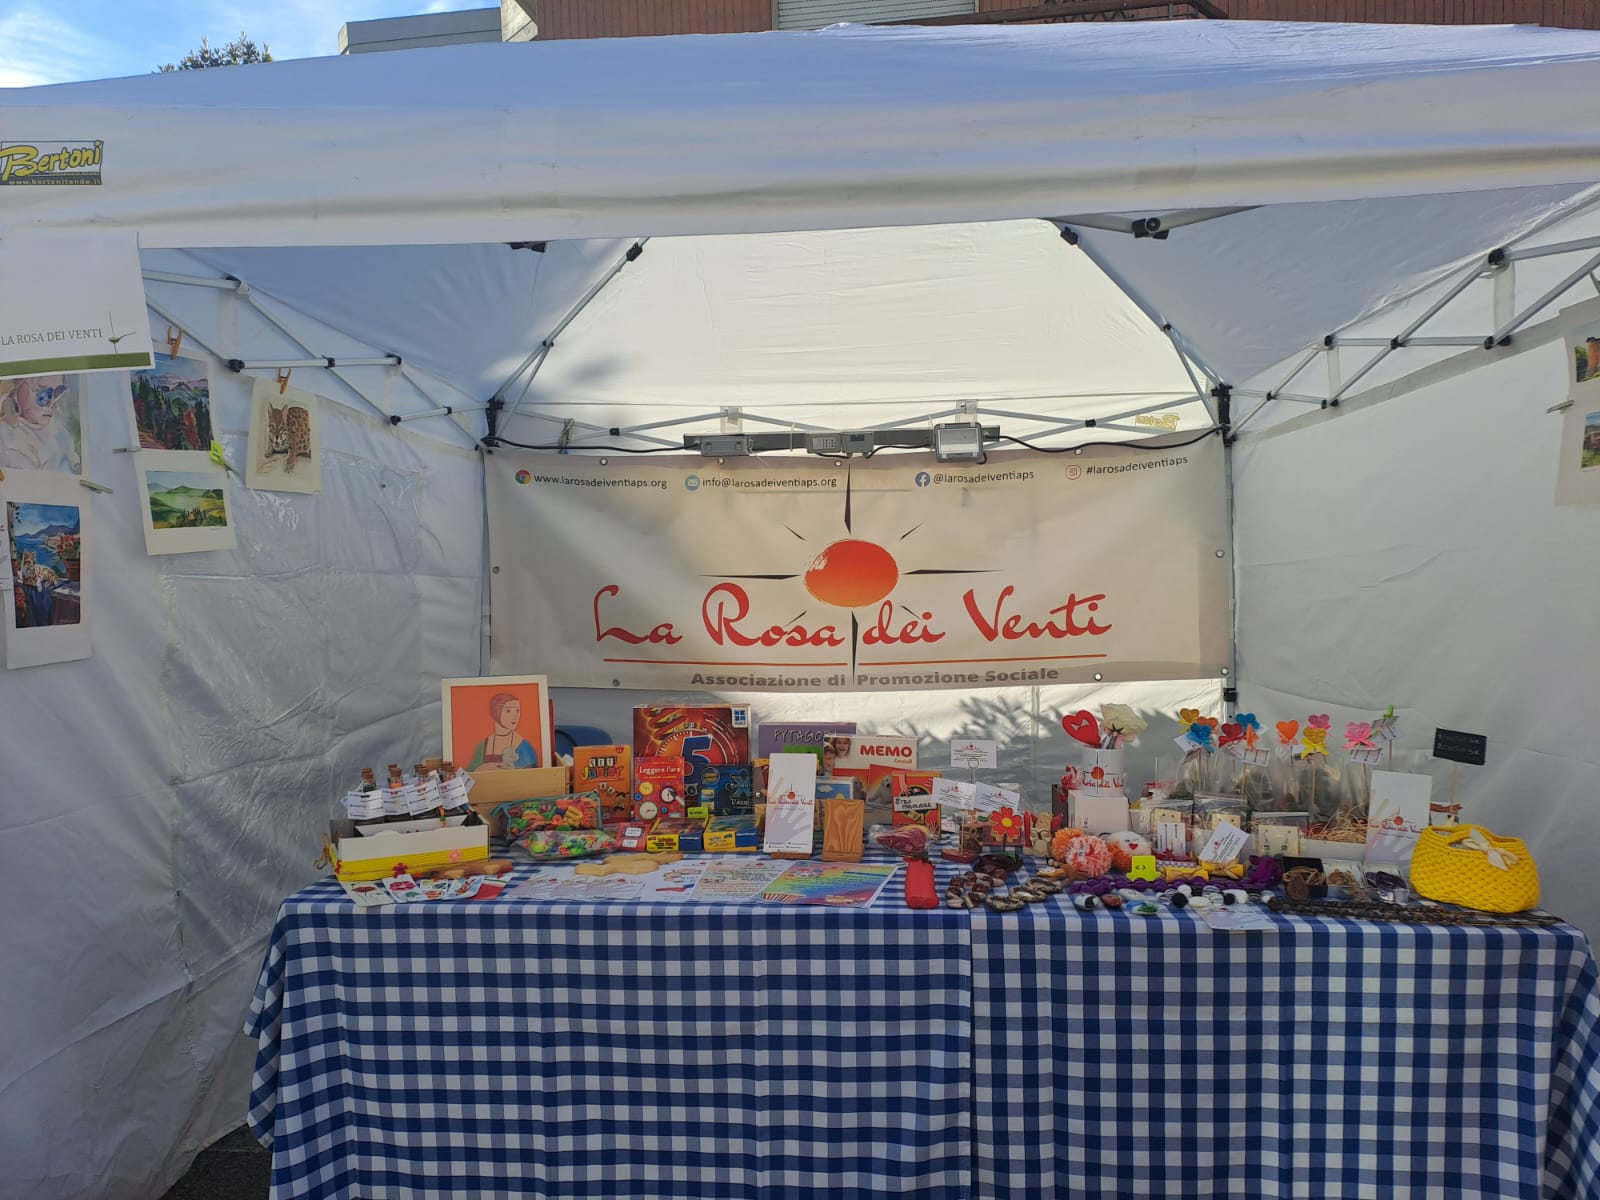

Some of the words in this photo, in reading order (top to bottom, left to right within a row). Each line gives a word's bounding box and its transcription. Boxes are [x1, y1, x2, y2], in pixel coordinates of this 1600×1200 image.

[0, 140, 103, 182] Bertoni
[1, 335, 15, 346] LA
[17, 332, 45, 344] ROSA
[47, 331, 66, 342] DEI
[68, 328, 103, 341] VENTI
[1086, 455, 1189, 476] #larosadeiventiaps
[533, 473, 667, 490] www.larosadeiventiaps.org
[702, 476, 837, 489] info@larosadeiventiaps.org
[933, 469, 1035, 484] @larosadeiventiaps
[593, 584, 683, 646] La
[702, 582, 846, 647] Rosa
[862, 599, 946, 646] dei
[963, 585, 1112, 642] Venti
[690, 672, 822, 687] Associazione
[827, 673, 846, 687] di
[857, 672, 979, 687] Promozione
[985, 668, 1059, 682] Sociale
[774, 728, 838, 743] PYTAGOR
[859, 744, 913, 758] MEMO
[639, 766, 665, 775] Leggere
